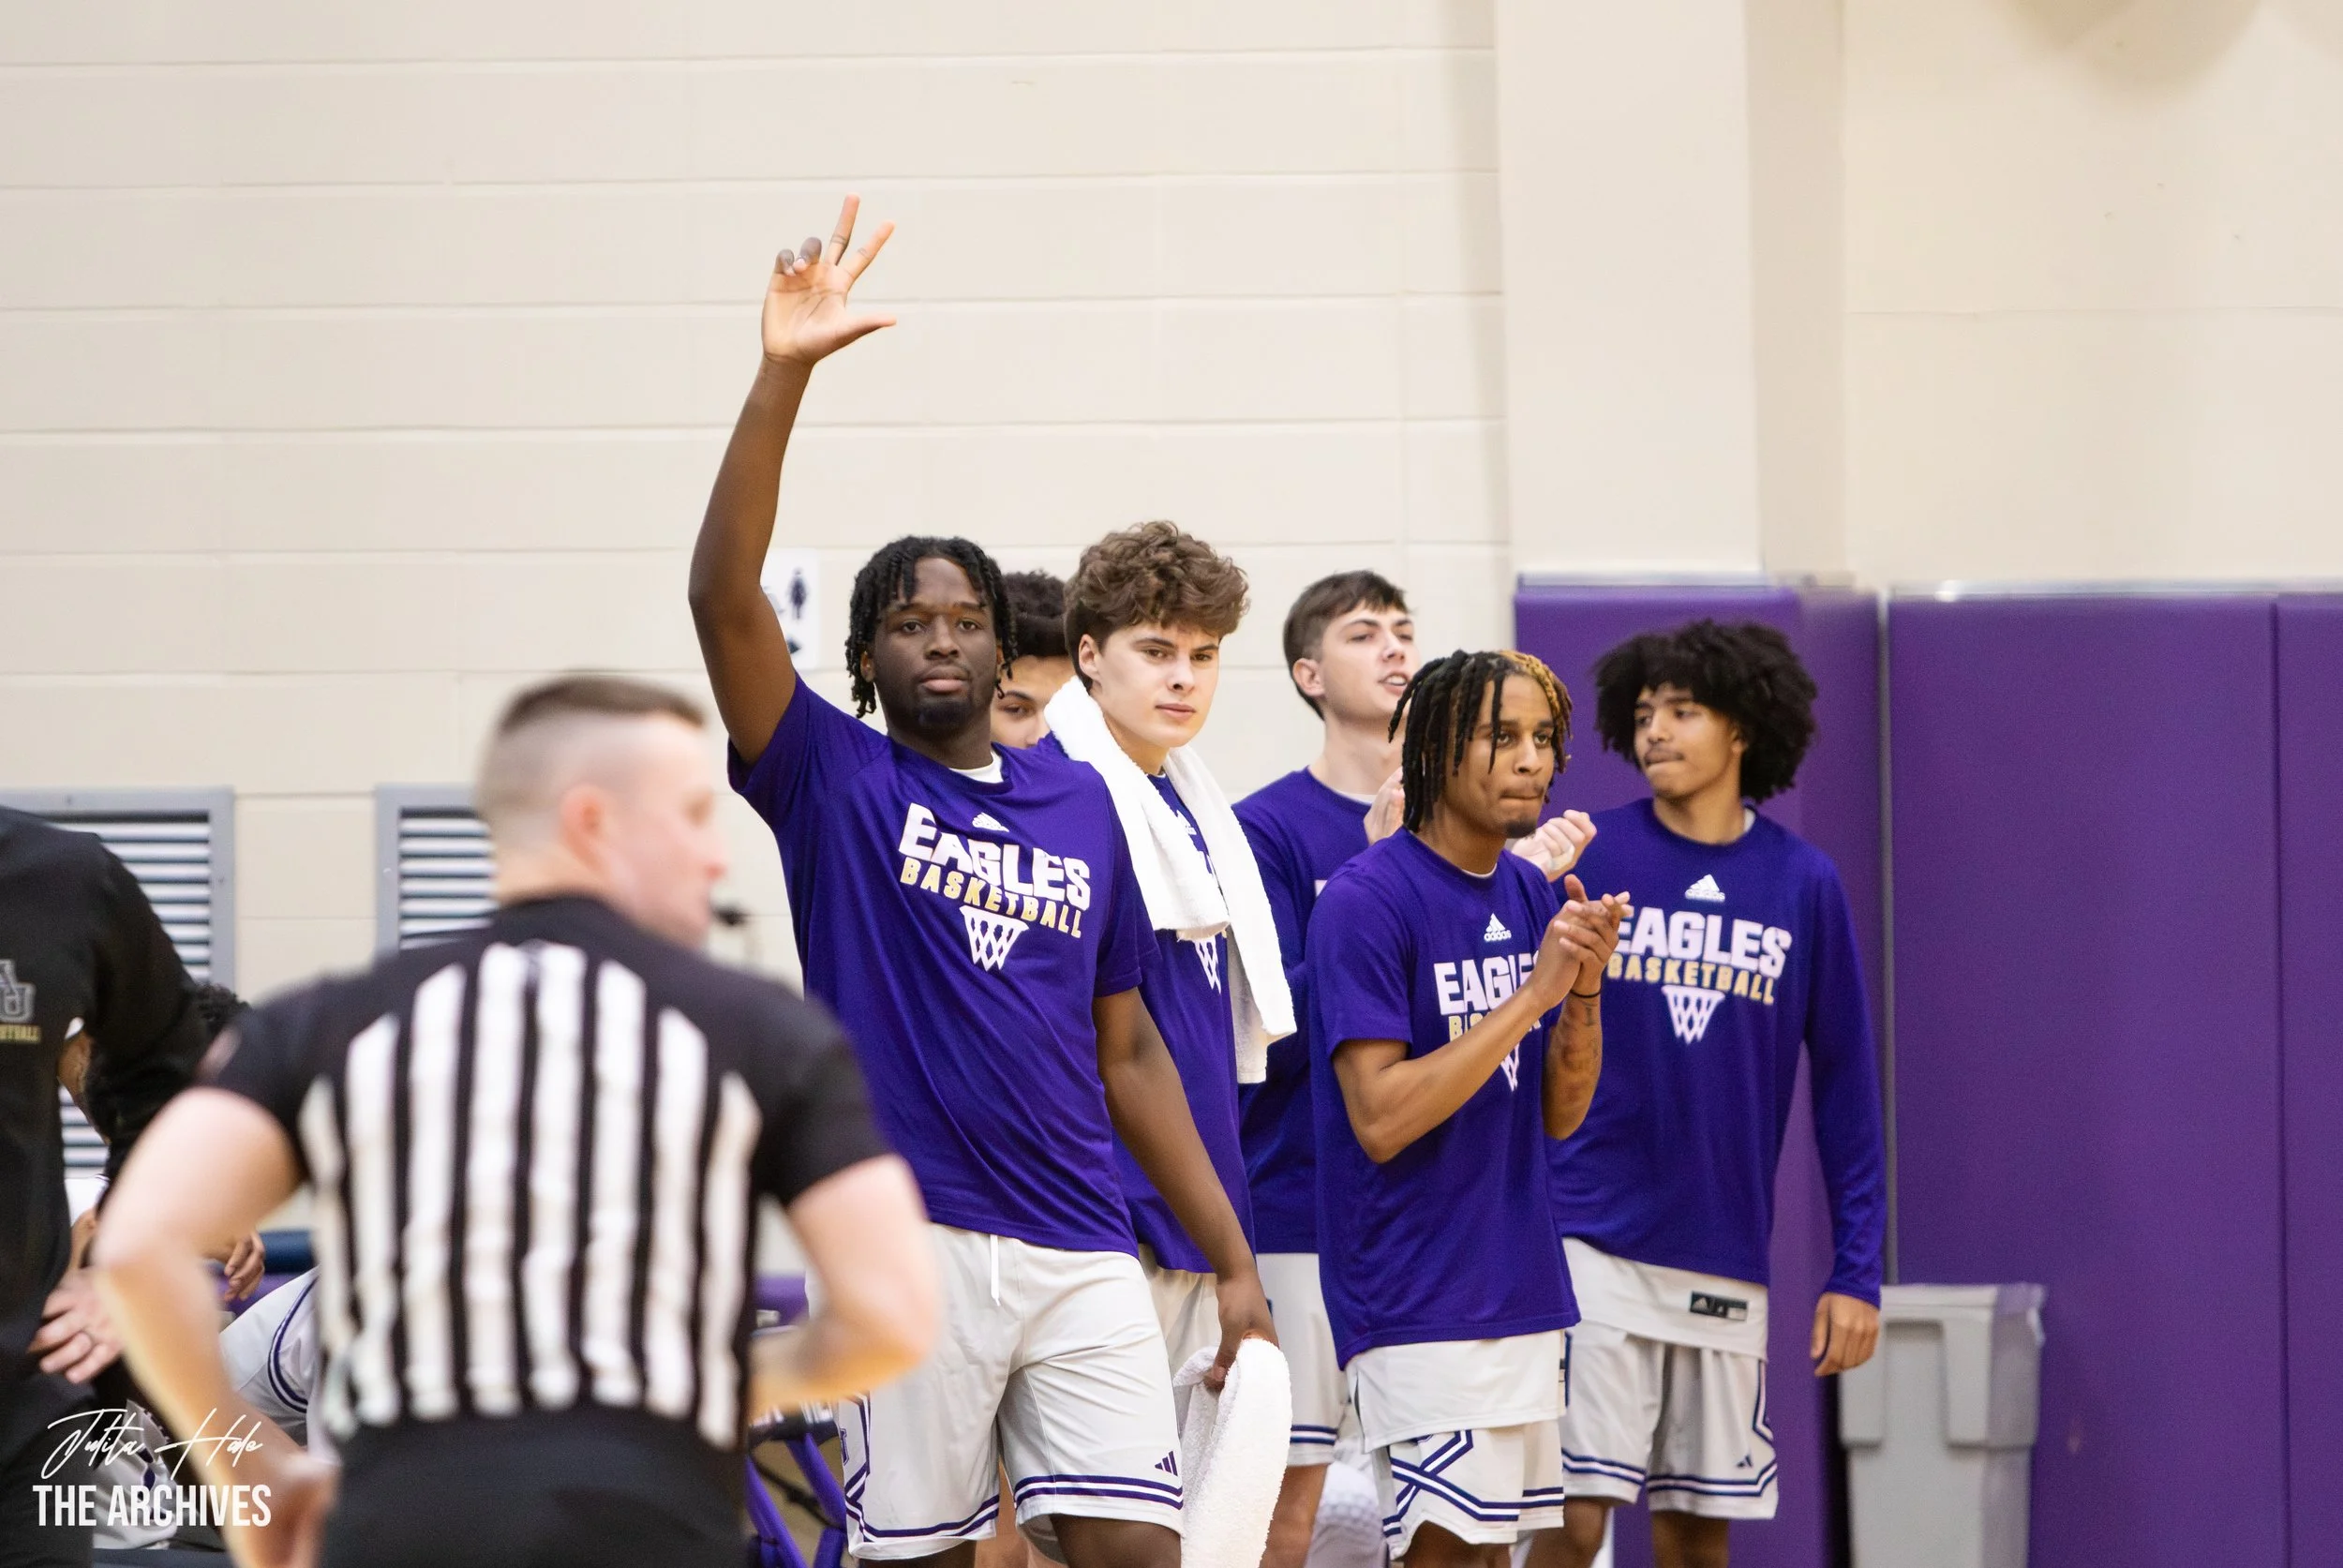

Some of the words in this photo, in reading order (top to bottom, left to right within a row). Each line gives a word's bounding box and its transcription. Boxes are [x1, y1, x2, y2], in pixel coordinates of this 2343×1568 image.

[899, 802, 1091, 911] EAGLES
[900, 857, 1082, 938] BASKETBALL
[1606, 952, 1774, 1006] BASKETBALL
